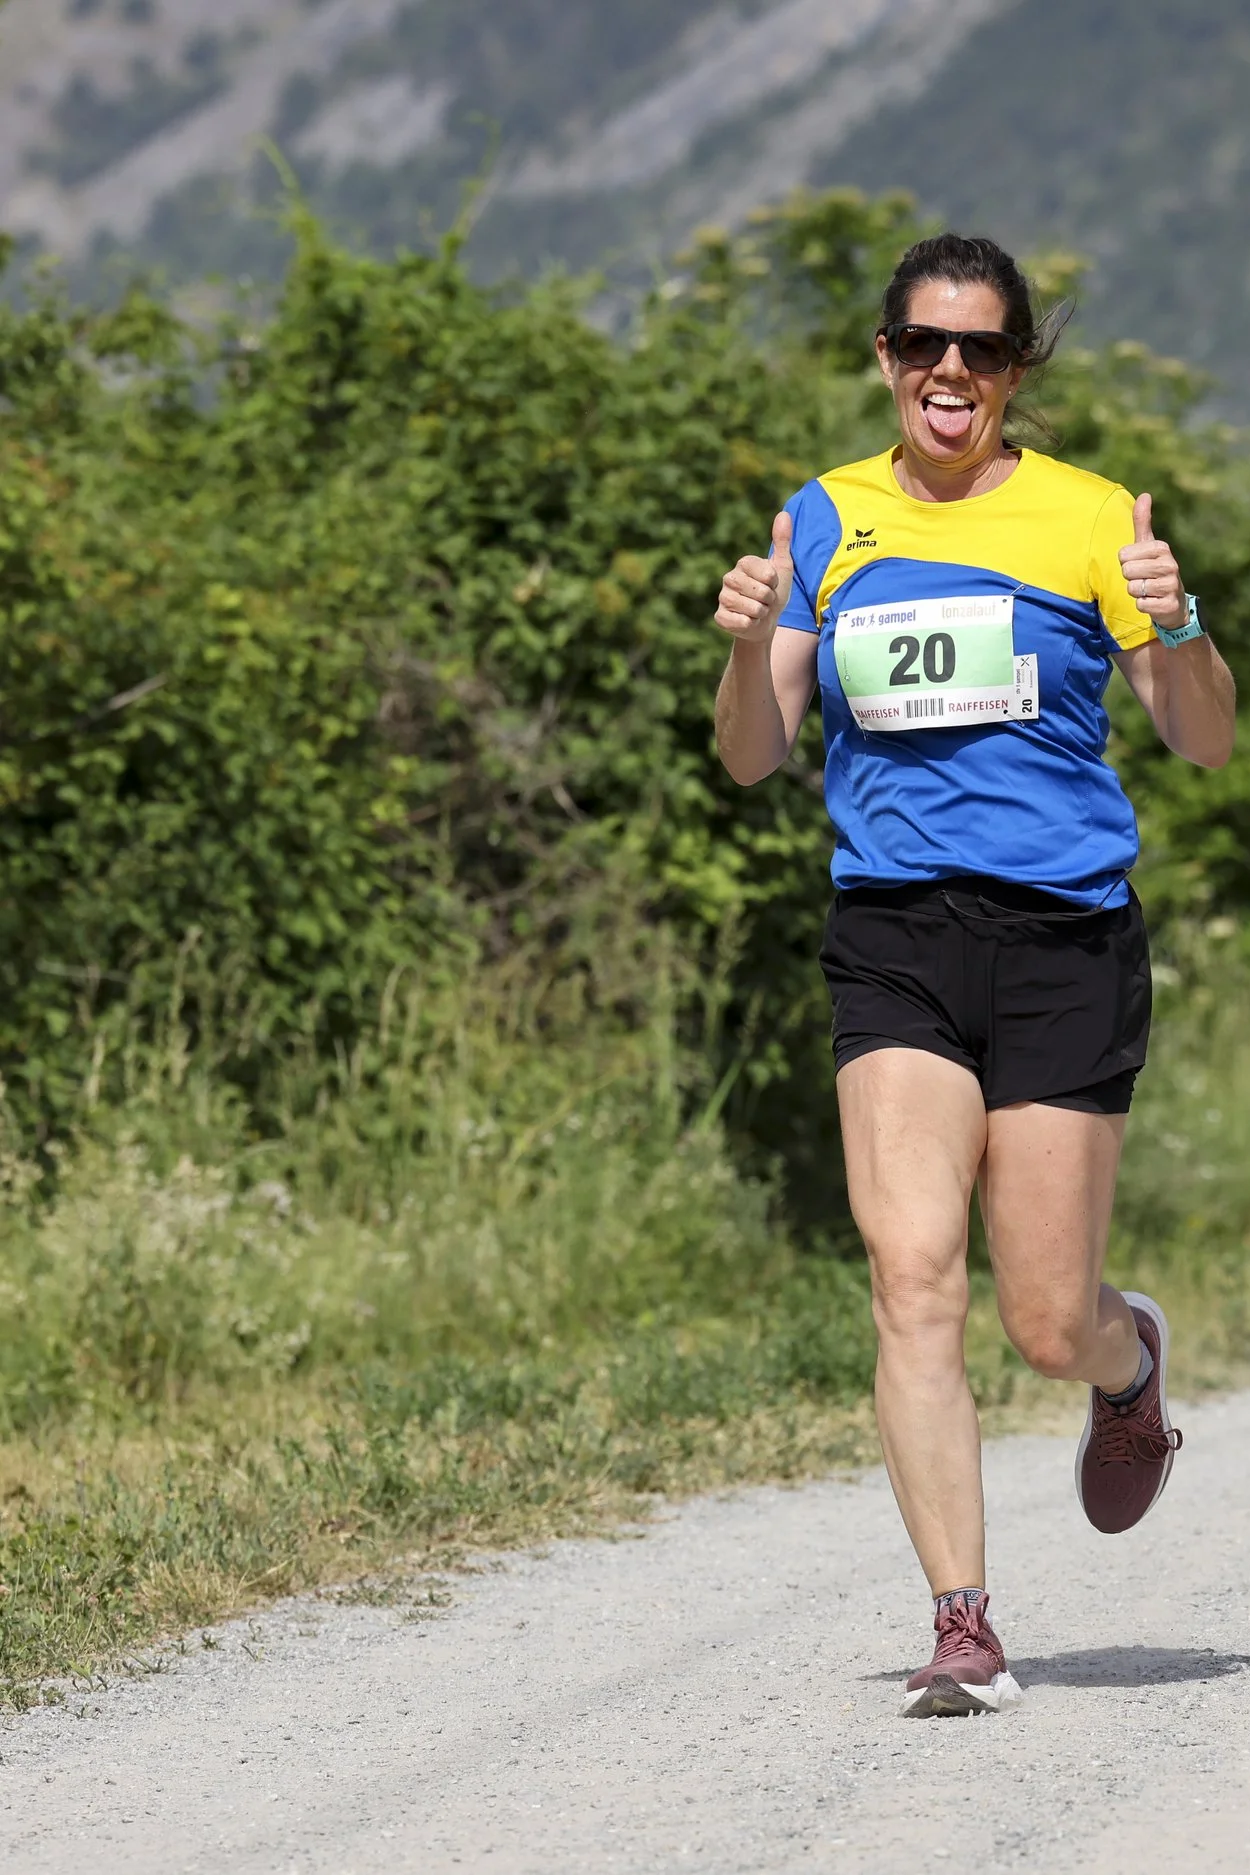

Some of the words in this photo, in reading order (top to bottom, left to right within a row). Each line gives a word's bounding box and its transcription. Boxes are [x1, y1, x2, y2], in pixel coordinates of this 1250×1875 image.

[846, 538, 877, 551] erima
[941, 601, 997, 619] lonzalauf
[851, 616, 866, 628] stv
[878, 609, 916, 626] gampel
[889, 632, 956, 686] 20
[948, 699, 1009, 713] RAIFFEISEN
[1022, 699, 1032, 713] 20
[855, 707, 900, 720] RAIFFEISEN
